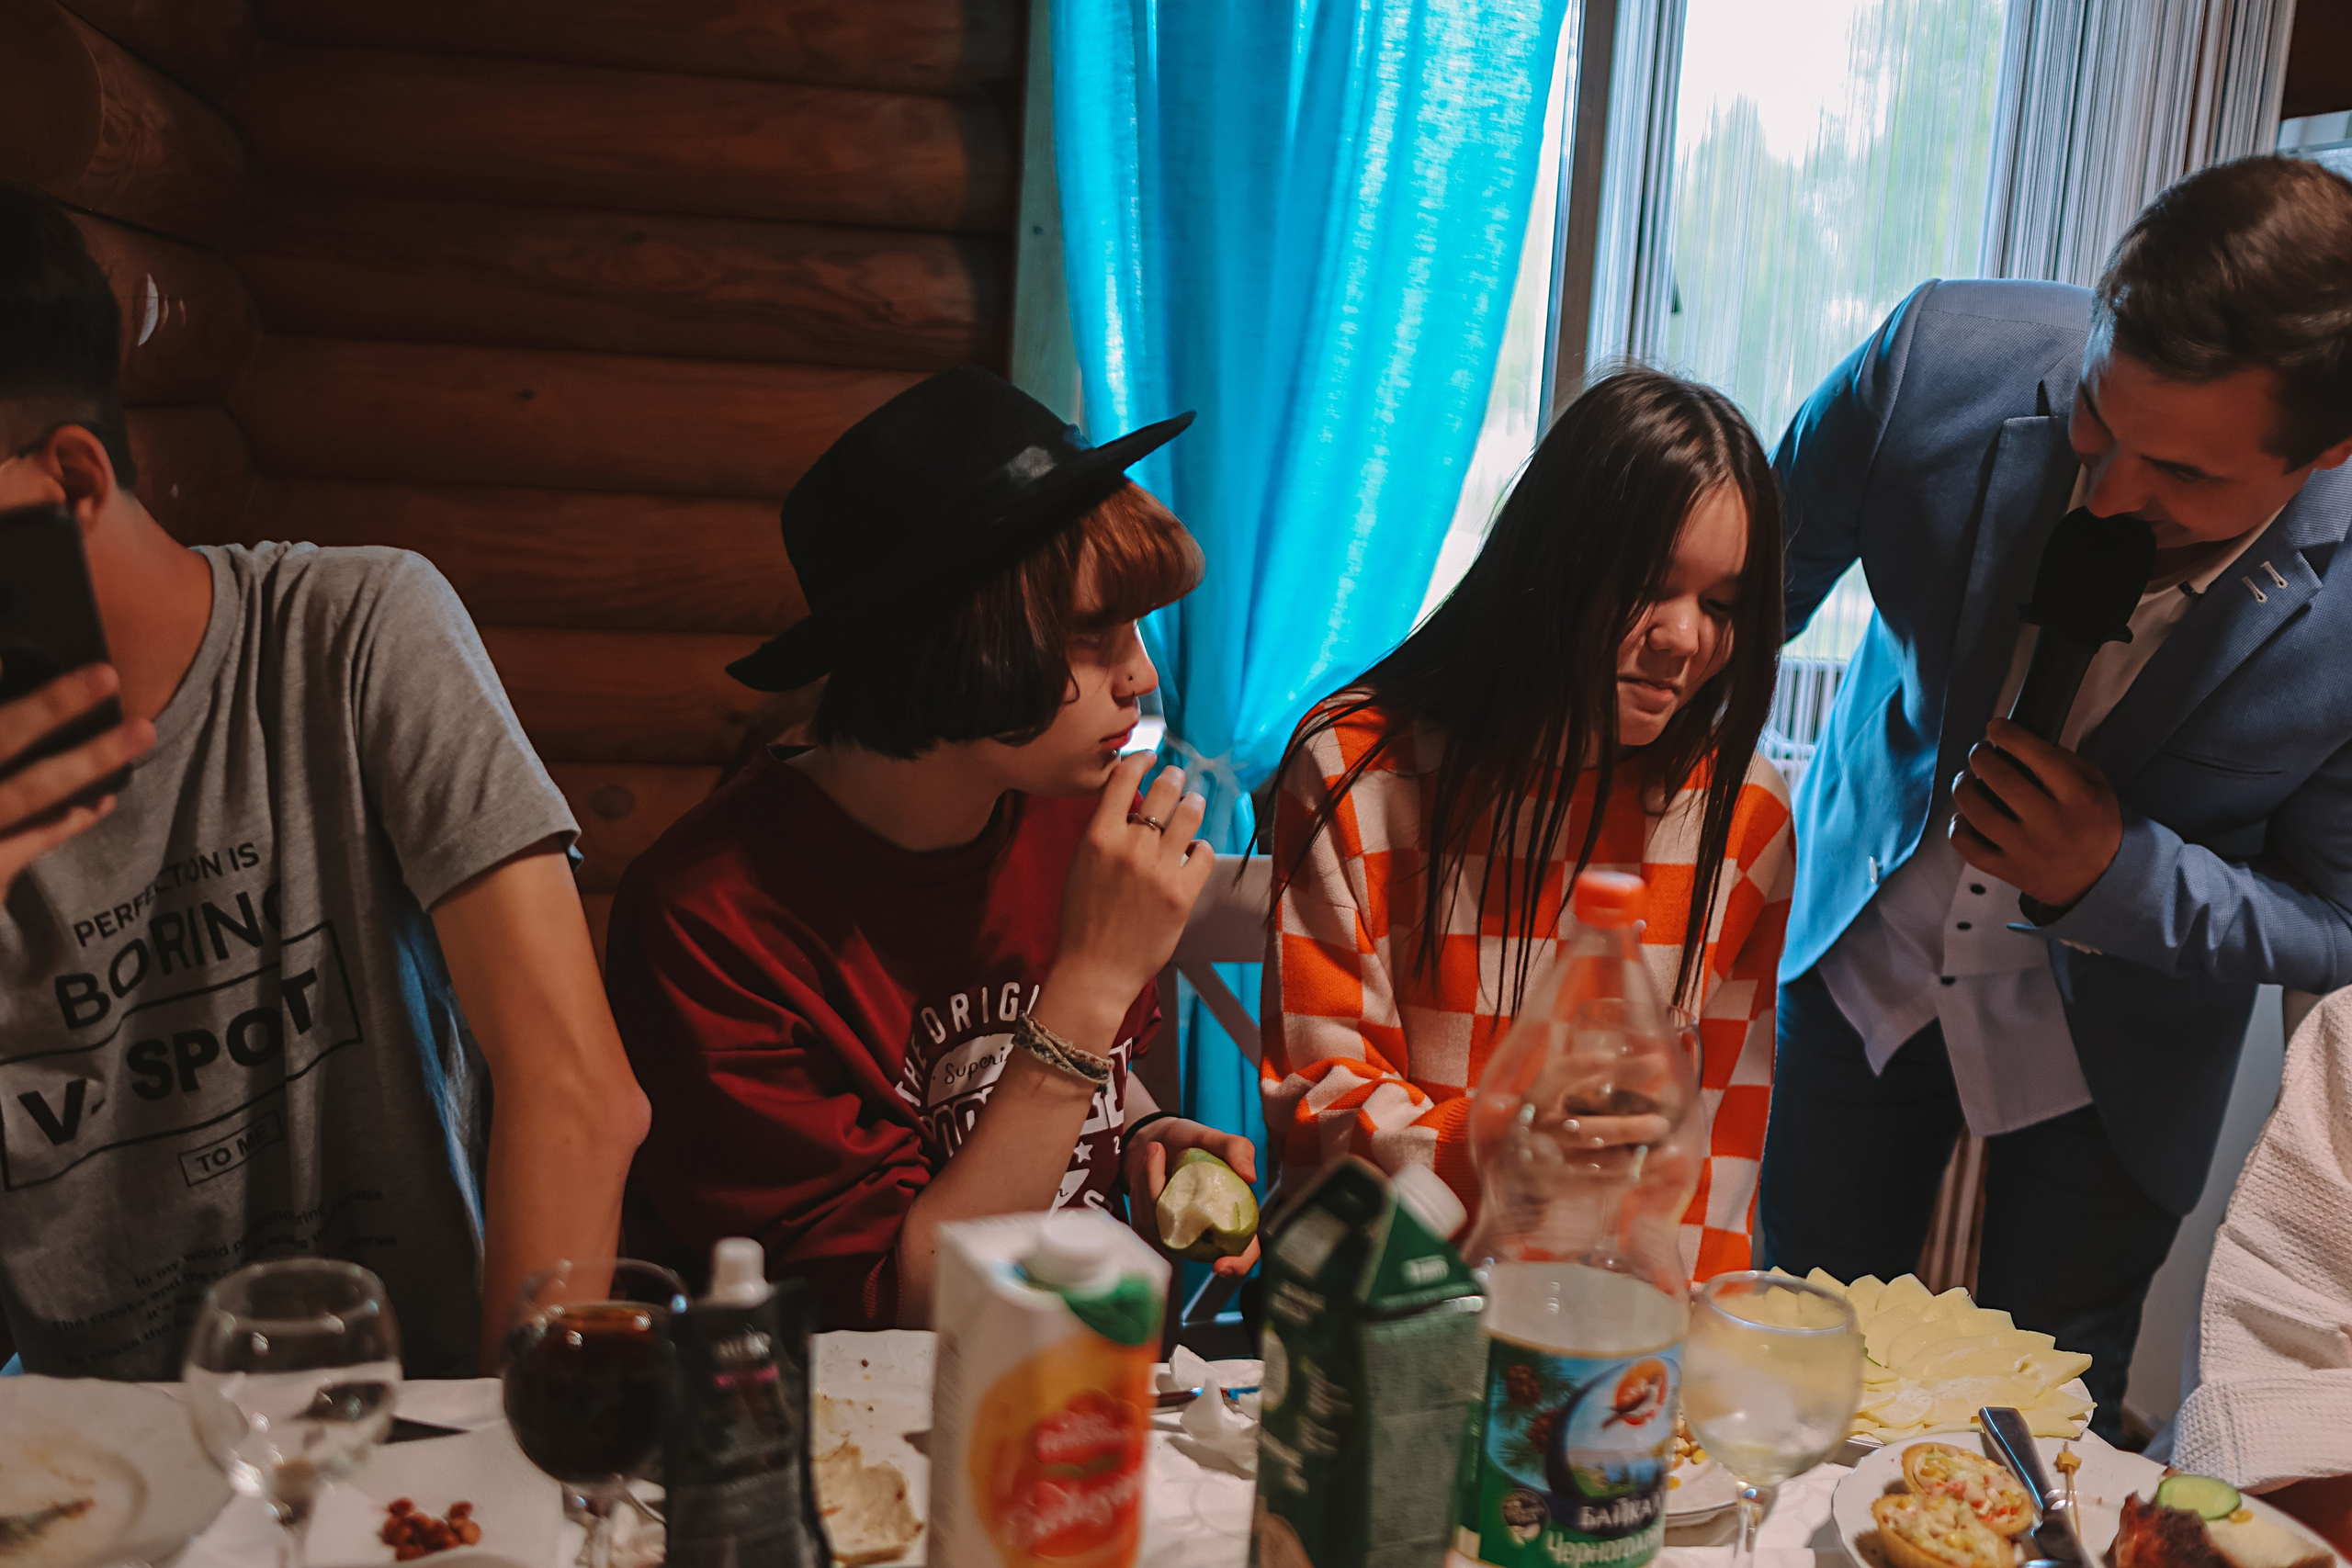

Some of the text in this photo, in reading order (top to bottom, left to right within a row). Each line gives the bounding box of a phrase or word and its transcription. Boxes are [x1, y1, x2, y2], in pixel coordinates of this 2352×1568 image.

[229, 842, 260, 872] IS
[921, 981, 1040, 1044] ORIGI
[944, 1046, 1008, 1085] Superi
[196, 1125, 272, 1172] TO ME
